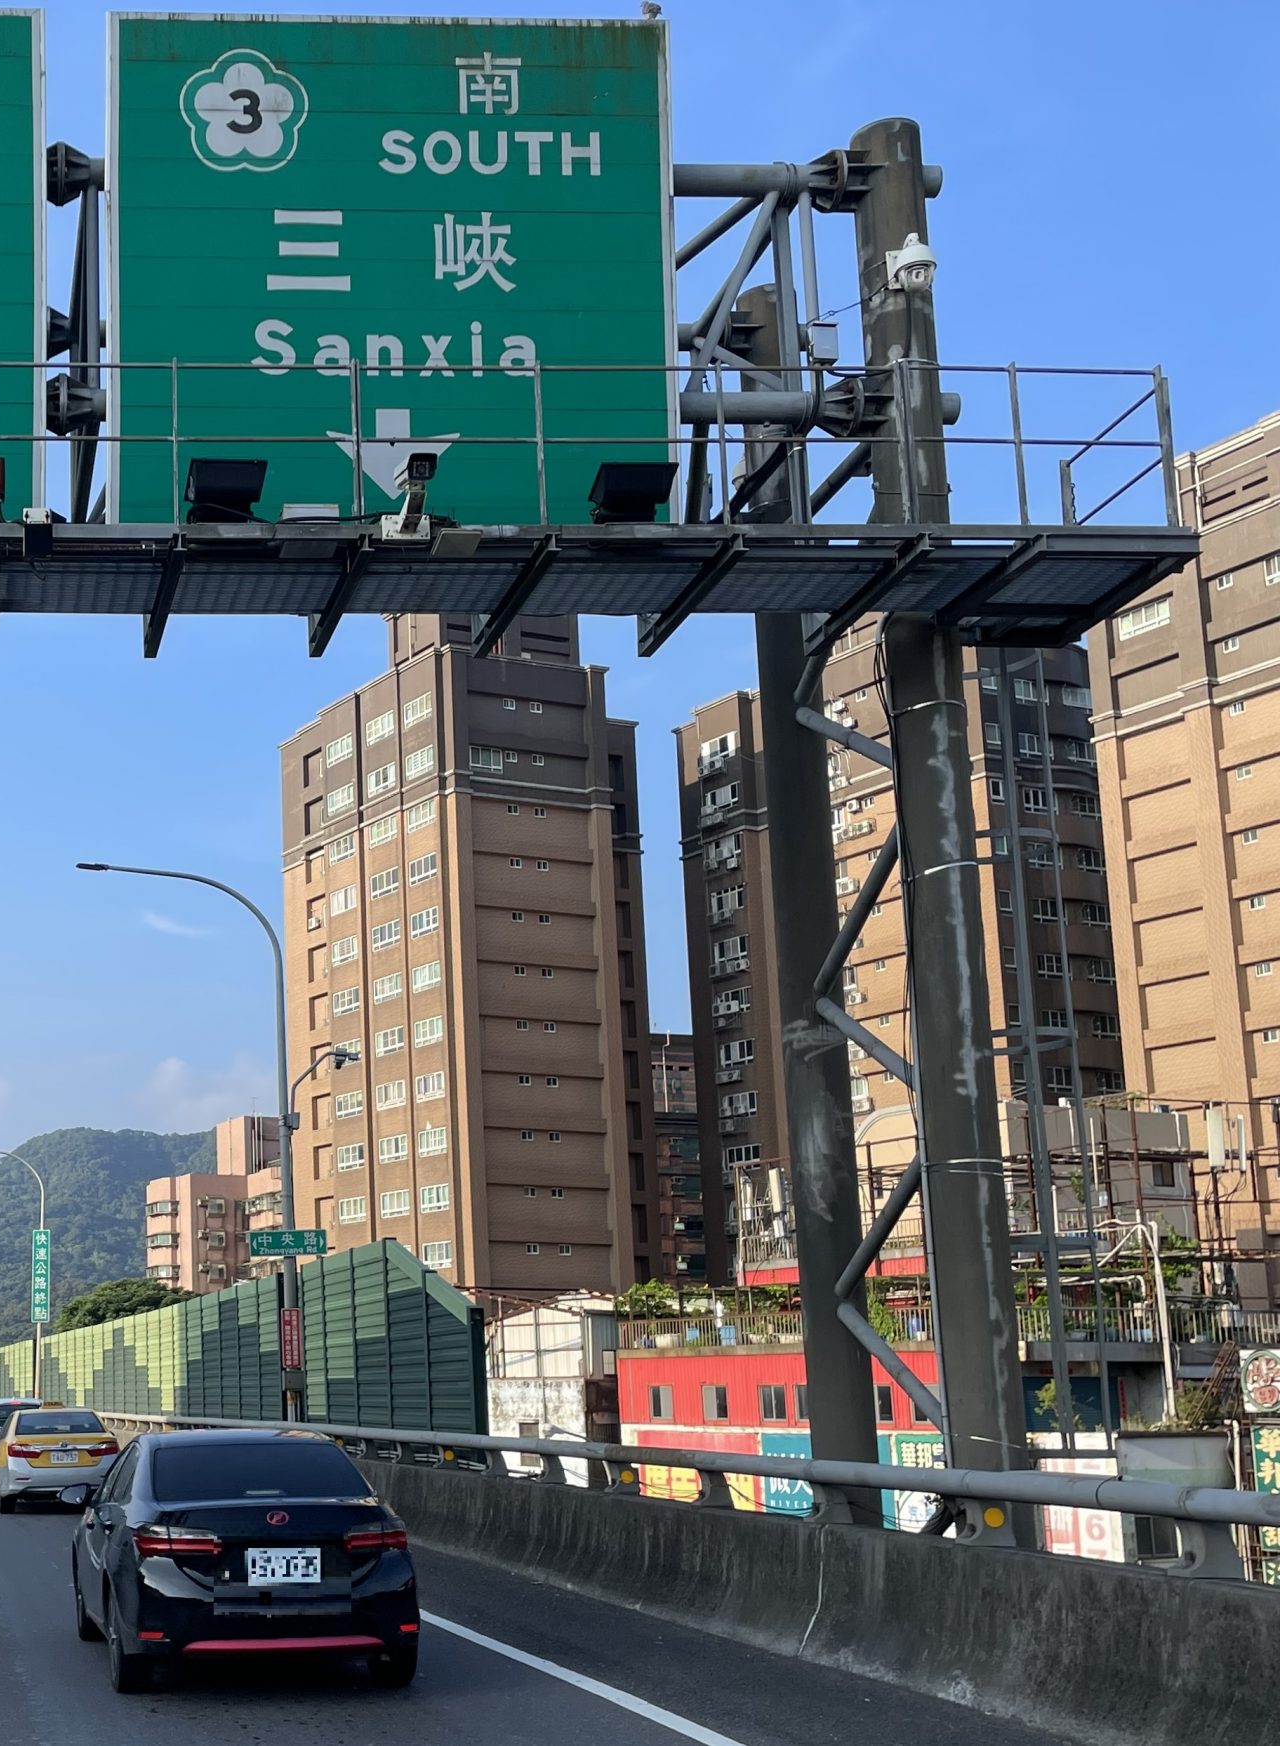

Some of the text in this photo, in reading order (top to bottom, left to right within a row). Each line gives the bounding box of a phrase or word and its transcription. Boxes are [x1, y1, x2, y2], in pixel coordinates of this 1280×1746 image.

[226, 89, 263, 134] 3
[455, 52, 521, 115] 南
[378, 130, 602, 176] SOUTH
[266, 209, 517, 293] 三峽
[250, 318, 537, 378] Sanxia
[257, 1232, 318, 1247] 中央路
[34, 1232, 48, 1320] 快速公路終點
